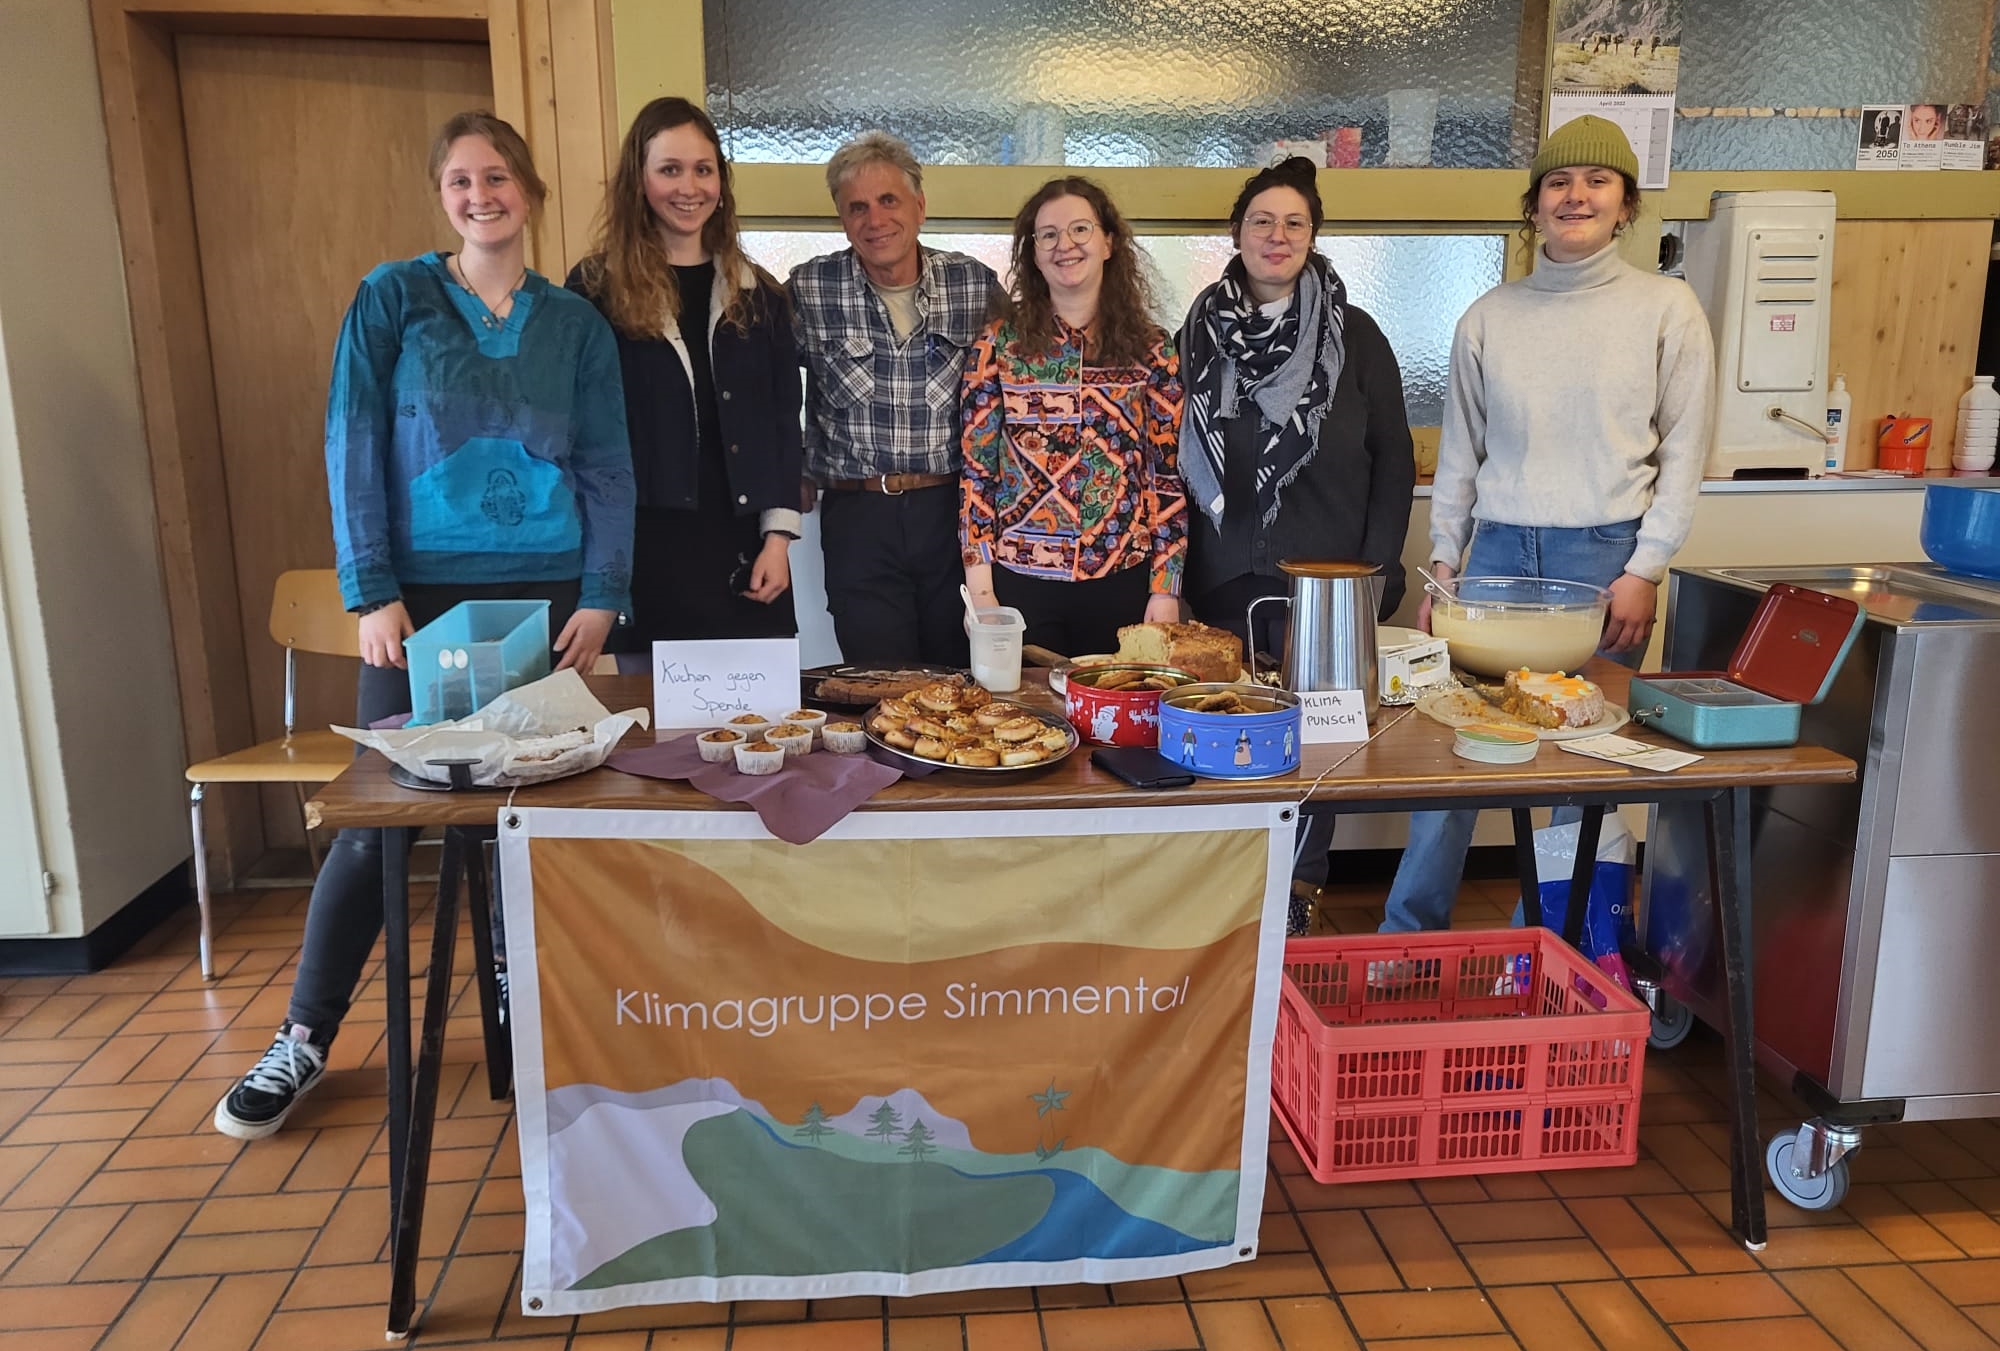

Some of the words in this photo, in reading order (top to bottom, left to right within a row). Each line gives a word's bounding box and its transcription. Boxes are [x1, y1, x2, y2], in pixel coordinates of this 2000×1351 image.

[1876, 149, 1898, 158] 2050
[661, 660, 711, 684] Kuchen
[726, 672, 766, 691] gegen
[691, 687, 752, 718] Spende
[1303, 695, 1342, 708] KLIMA
[616, 988, 927, 1037] Klimagruppe
[943, 975, 1190, 1019] Simmental
